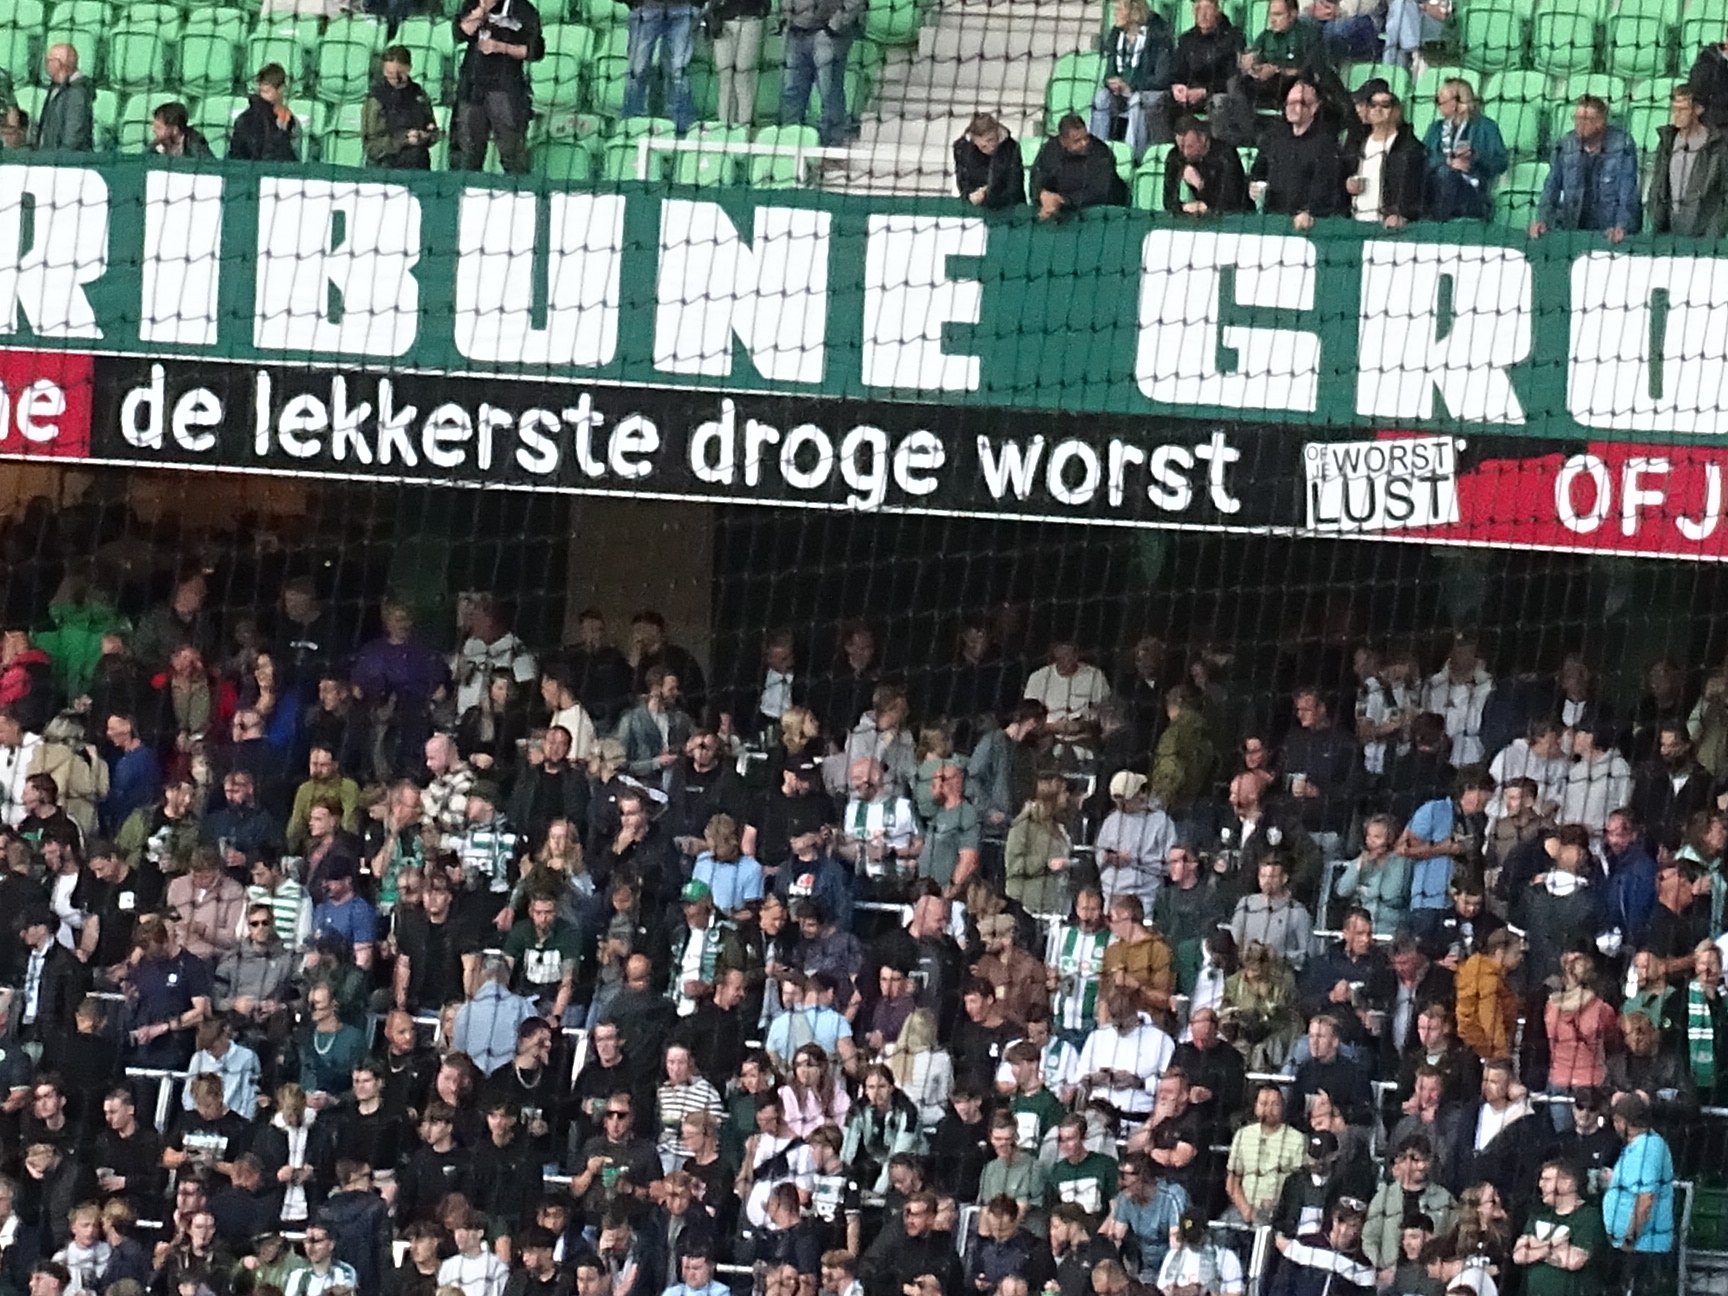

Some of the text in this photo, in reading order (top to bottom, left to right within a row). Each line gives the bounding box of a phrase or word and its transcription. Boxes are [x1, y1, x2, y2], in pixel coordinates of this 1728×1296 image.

[120, 364, 1241, 514] de lekkerste droge worst
[1333, 442, 1449, 474] WORST
[1312, 475, 1450, 523] LUST
